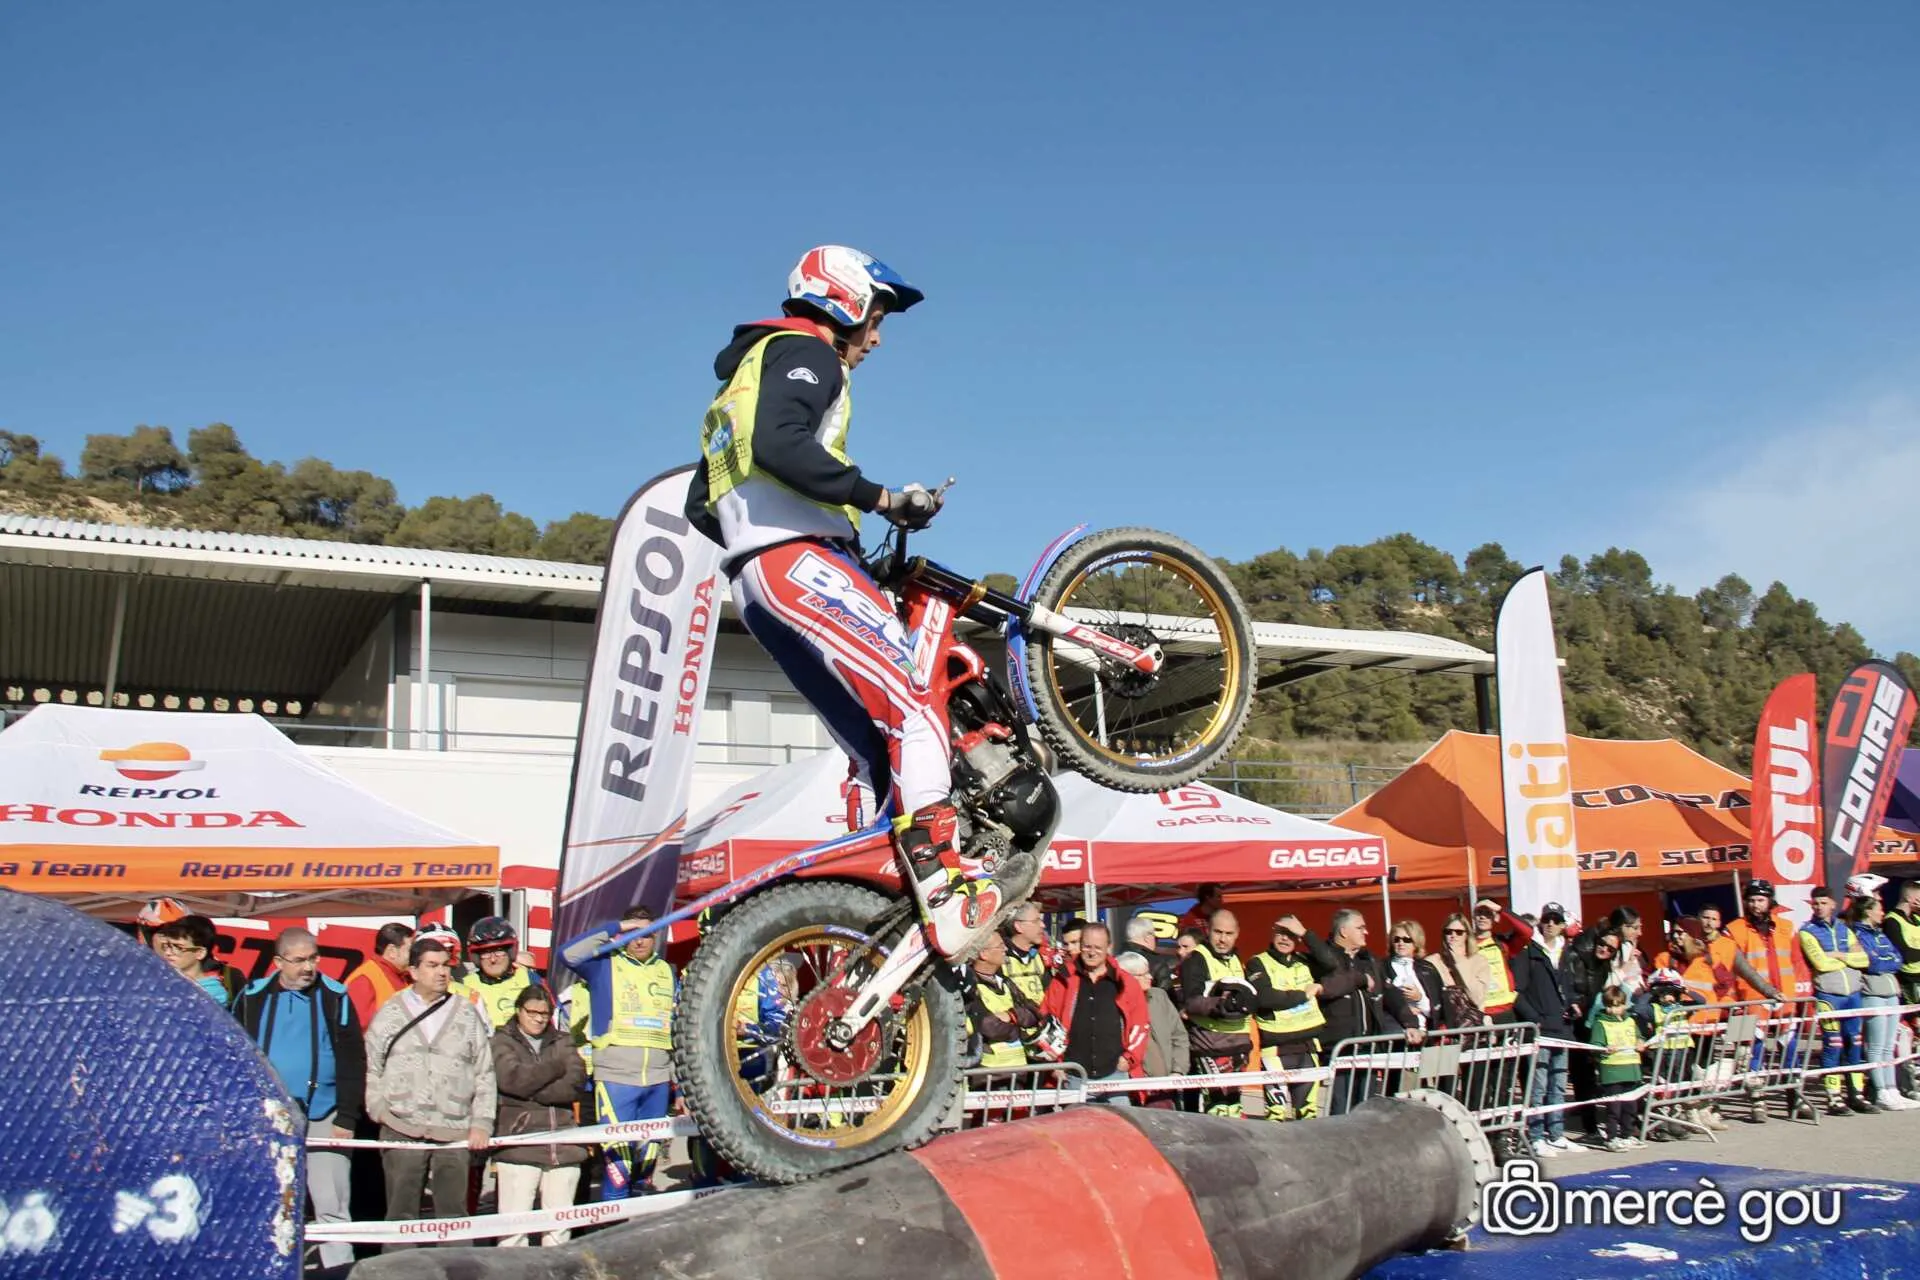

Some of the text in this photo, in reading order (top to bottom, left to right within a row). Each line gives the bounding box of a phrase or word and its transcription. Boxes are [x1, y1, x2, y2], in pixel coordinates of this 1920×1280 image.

[805, 593, 902, 660] RACING
[601, 506, 690, 802] REPSOL
[673, 574, 716, 737] HONDA
[1831, 675, 1904, 856] COMAS
[79, 784, 221, 800] REPSOL
[0, 804, 306, 829] HONDA
[1156, 814, 1272, 828] GASGAS
[1268, 846, 1381, 869] GASGAS
[32, 860, 127, 878] Team
[179, 860, 493, 880] Repsol Honda Team
[604, 1119, 671, 1139] octagon
[555, 1202, 621, 1224] octagon
[399, 1219, 471, 1240] octagon
